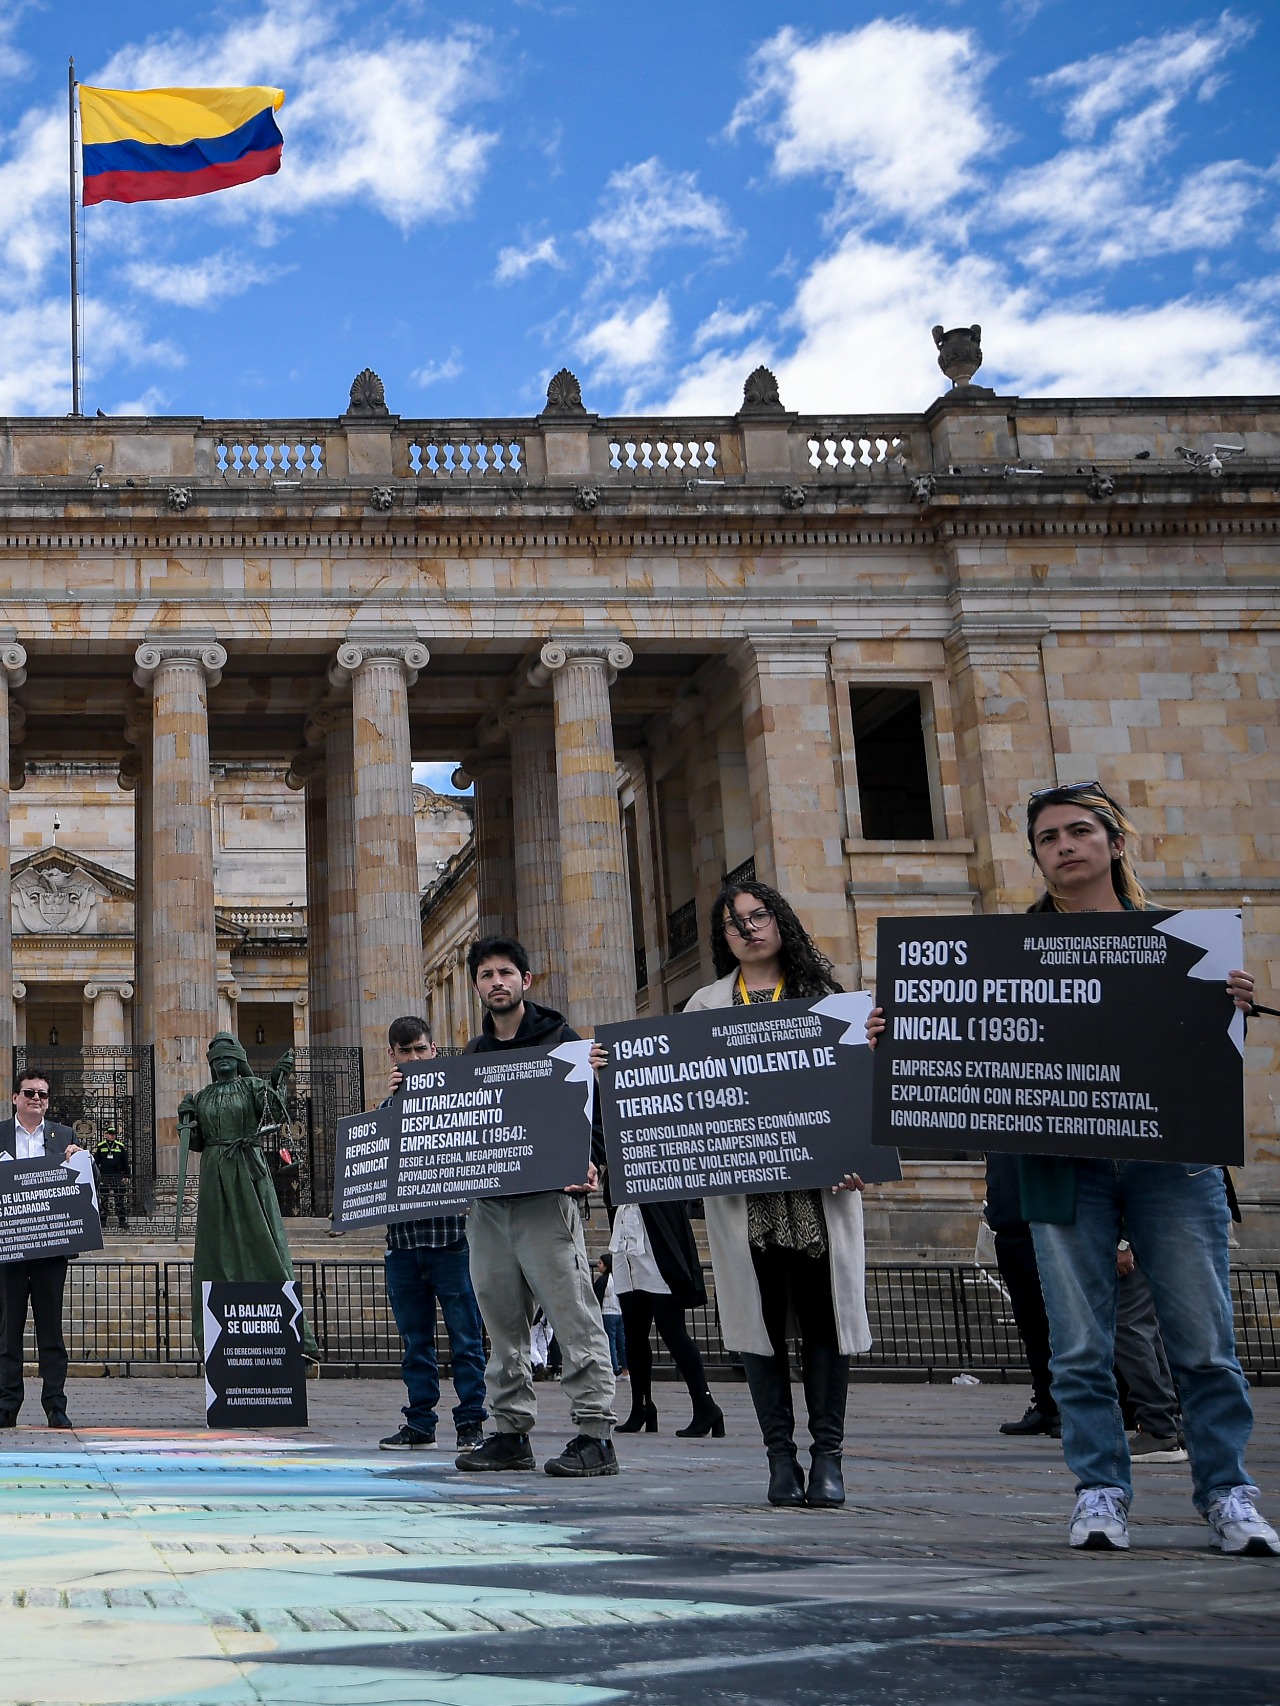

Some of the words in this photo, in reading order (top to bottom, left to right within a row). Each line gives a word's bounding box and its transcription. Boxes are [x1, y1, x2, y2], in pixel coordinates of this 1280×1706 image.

[897, 940, 967, 965] 1930'S
[1023, 935, 1166, 950] #LAJUSTICIASEFRACTURA
[1039, 949, 1079, 964] ¿QUIÉN
[1082, 950, 1097, 964] LA
[1099, 950, 1166, 964] FRACTURA?
[894, 978, 977, 1002] DESPOJO
[982, 978, 1100, 1003] PETROLERO
[711, 1015, 821, 1037] #LAJUSTICIASEFRACTURA
[726, 1033, 757, 1046] ¿QUIÉN
[758, 1031, 771, 1042] LA
[771, 1025, 821, 1041] FRACTURA?
[893, 1016, 962, 1040] INICIAL
[967, 1017, 1044, 1041] (1936):
[612, 1034, 669, 1060] 1940'S
[474, 1058, 552, 1075] #LAJUSTICIASEFRACTURA
[482, 1072, 505, 1083] ¿QUIÉN
[506, 1071, 515, 1080] LA
[515, 1067, 552, 1079] FRACTURA?
[614, 1055, 727, 1089] ACUMULACIÓN
[729, 1049, 810, 1075] VIOLENTA
[812, 1046, 836, 1067] DE
[891, 1059, 961, 1077] EMPRESAS
[965, 1060, 1062, 1080] EXTRANJERAS
[1066, 1063, 1119, 1081] INICIAN
[402, 1087, 491, 1114] MILITARIZACIÓN
[494, 1088, 503, 1103] Y
[615, 1092, 683, 1118] TIERRAS
[686, 1086, 749, 1110] (1948):
[891, 1083, 979, 1103] EXPLOTACIÓN
[983, 1087, 1011, 1104] CON
[1015, 1088, 1087, 1107] RESPALDO
[1091, 1091, 1157, 1112] ESTATAL,
[401, 1107, 502, 1133] DESPLAZAMIENTO
[619, 1129, 634, 1143] SE
[635, 1122, 703, 1141] CONSOLIDAN
[705, 1117, 755, 1134] PODERES
[757, 1109, 830, 1129] ECONÓMICOS
[890, 1109, 966, 1128] IGNORANDO
[970, 1112, 1042, 1132] DERECHOS
[1045, 1115, 1162, 1137] TERRITORIALES.
[345, 1136, 389, 1159] REPRESIÓN
[399, 1129, 479, 1152] EMPRESARIAL
[482, 1125, 526, 1143] (1954):
[621, 1143, 657, 1160] SOBRE
[658, 1139, 705, 1156] TIERRAS
[706, 1132, 778, 1151] CAMPESINAS
[780, 1130, 796, 1144] EN
[344, 1164, 350, 1178] A
[351, 1156, 388, 1176] SINDICAT
[398, 1155, 423, 1168] DESDE
[424, 1154, 435, 1165] LA
[436, 1152, 463, 1164] FECHA,
[465, 1144, 533, 1161] MEGAPROYECTOS
[623, 1158, 680, 1176] CONTEXTO
[681, 1156, 697, 1171] DE
[698, 1151, 757, 1169] VIOLENCIA
[758, 1146, 813, 1164] POLÍTICA.
[397, 1168, 437, 1182] APOYADOS
[438, 1167, 454, 1178] POR
[455, 1163, 486, 1177] FUERZA
[487, 1160, 520, 1174] PÚBLICA
[625, 1174, 682, 1193] SITUACIÓN
[684, 1173, 706, 1188] QUE
[709, 1169, 732, 1186] AÚN
[733, 1166, 791, 1183] PERSISTE.
[1, 1193, 12, 1204] DE
[12, 1184, 80, 1202] ULTRAPROCESADOS
[396, 1182, 441, 1196] DESPLAZAN
[442, 1176, 501, 1192] COMUNIDADES.
[3, 1201, 50, 1216] AZUCARADAS
[224, 1304, 236, 1317] LA
[238, 1303, 282, 1317] BALANZA
[227, 1320, 240, 1333] SE
[241, 1317, 282, 1334] QUEBRÓ.
[226, 1396, 292, 1405] #LAJUSTICIASEFRACTURA
